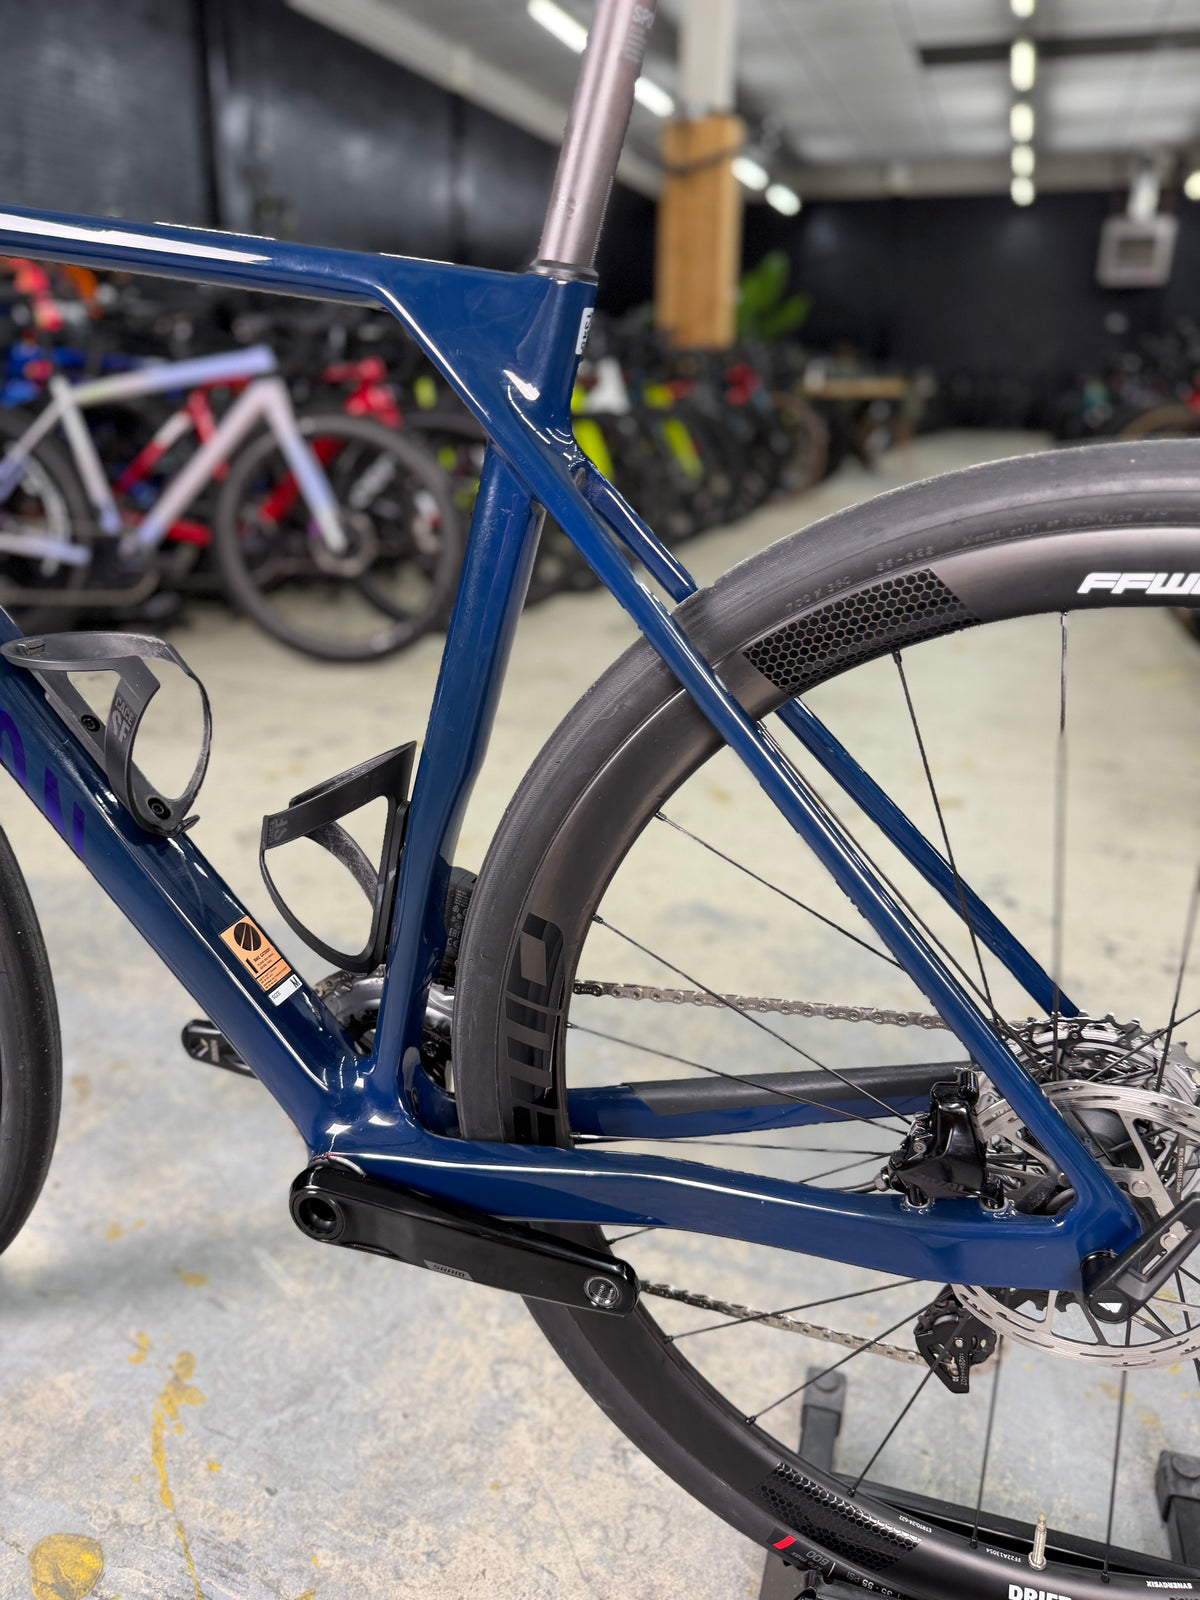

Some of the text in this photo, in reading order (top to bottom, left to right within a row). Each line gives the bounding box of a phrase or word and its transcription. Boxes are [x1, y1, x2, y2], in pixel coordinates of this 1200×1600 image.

[1077, 572, 1200, 595] FFW
[290, 976, 301, 988] M
[433, 1265, 464, 1277] SRAM
[805, 1550, 830, 1566] 600
[847, 1571, 861, 1584] PSI
[861, 1578, 874, 1591] 55
[1008, 1584, 1072, 1600] DRI
